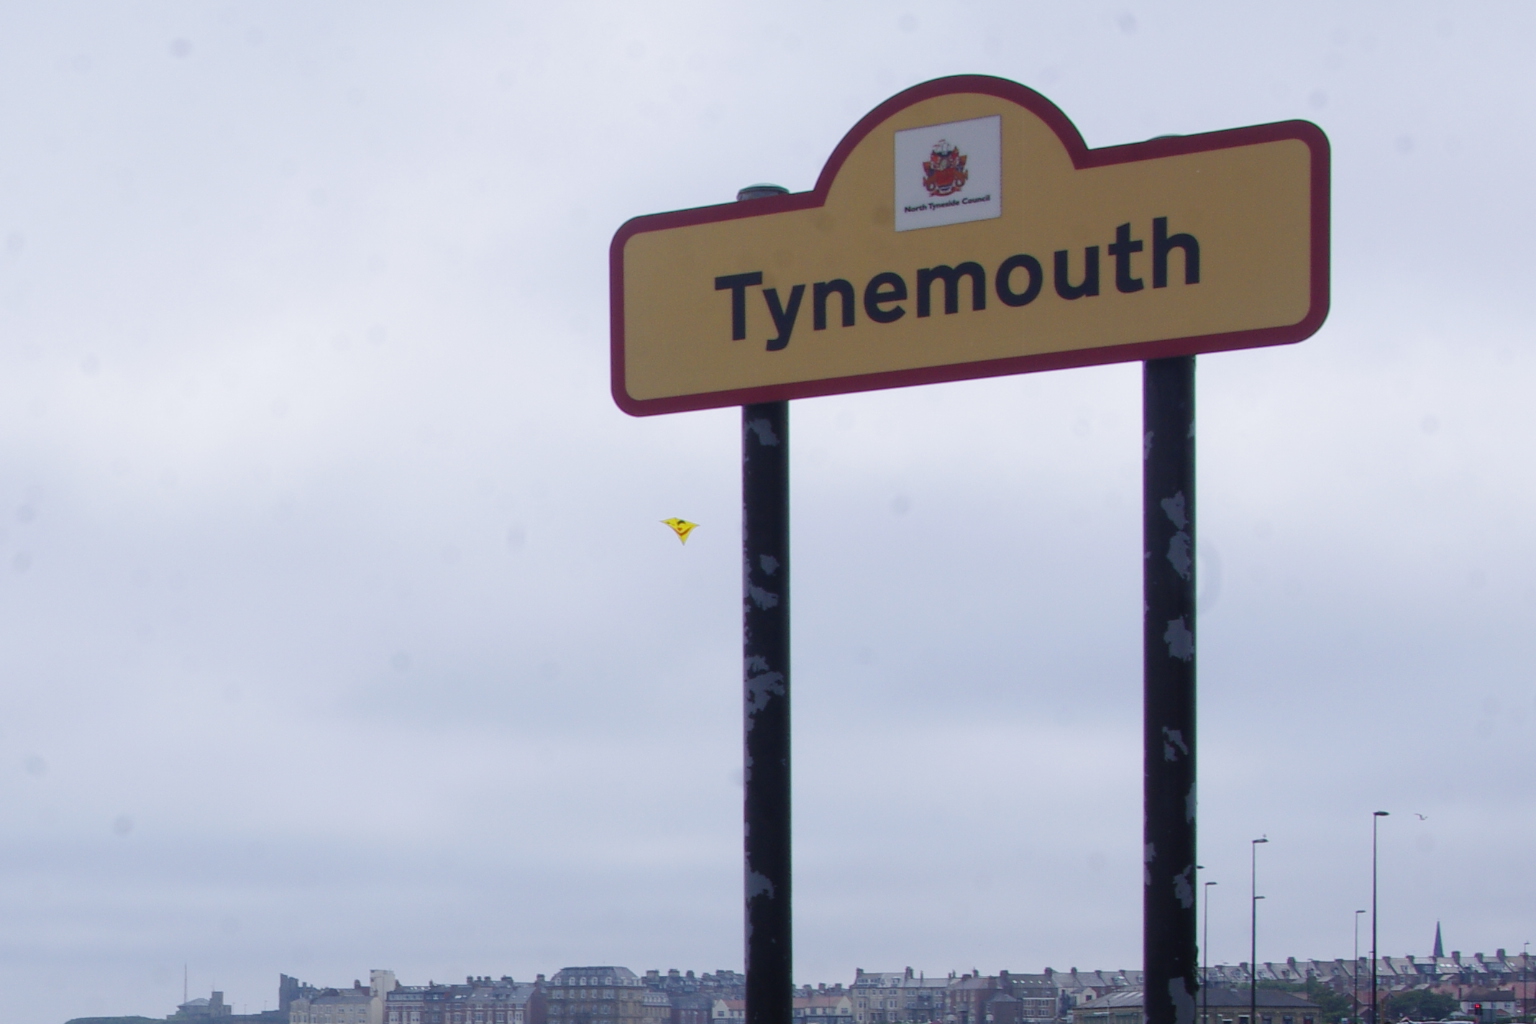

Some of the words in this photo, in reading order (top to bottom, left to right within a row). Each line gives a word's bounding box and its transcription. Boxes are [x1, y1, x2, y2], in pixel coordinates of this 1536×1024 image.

[904, 204, 927, 213] North
[928, 200, 960, 210] Tyneside
[962, 195, 991, 205] Council
[714, 216, 1200, 351] Tynemouth
